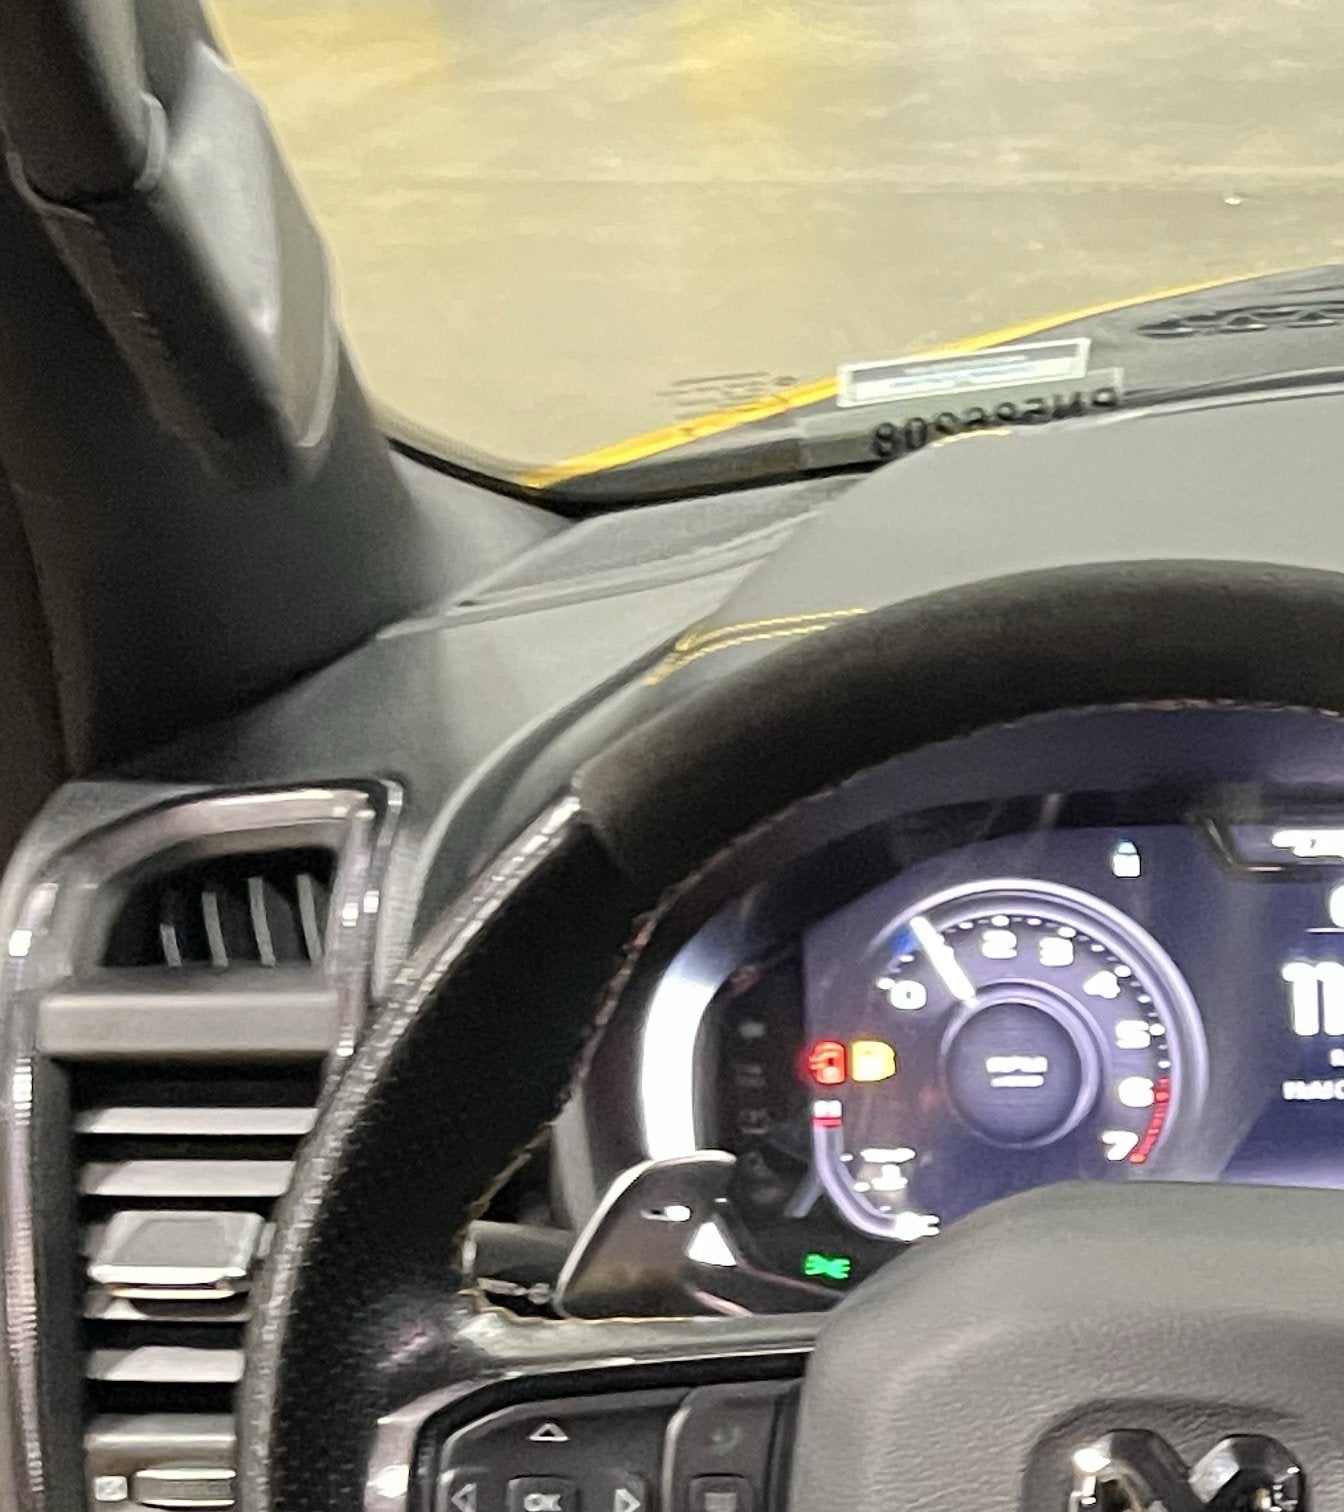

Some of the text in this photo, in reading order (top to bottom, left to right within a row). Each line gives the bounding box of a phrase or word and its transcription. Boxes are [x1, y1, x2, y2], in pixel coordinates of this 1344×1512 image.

[982, 930, 1017, 959] 2
[1039, 937, 1074, 967] 3
[889, 981, 927, 1010] 0
[1115, 1020, 1151, 1049] 5
[1119, 1077, 1154, 1107] 6
[1102, 1131, 1139, 1161] 7
[523, 1492, 562, 1512] OK
